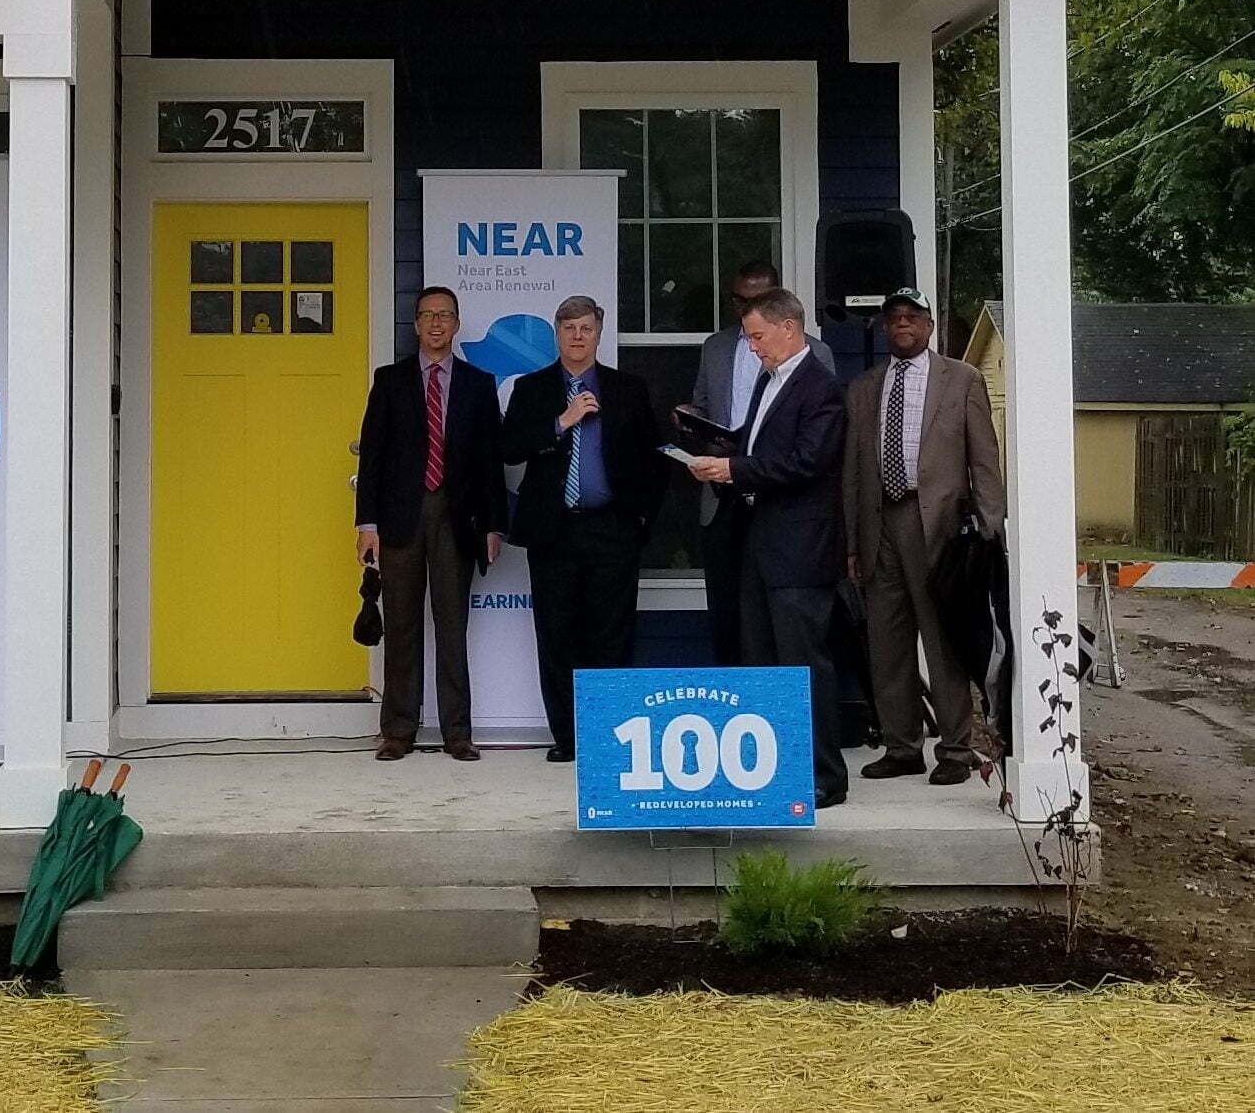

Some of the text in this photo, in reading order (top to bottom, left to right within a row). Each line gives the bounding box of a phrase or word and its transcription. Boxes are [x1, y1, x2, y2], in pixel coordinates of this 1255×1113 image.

[203, 108, 316, 149] 2517
[457, 222, 584, 256] NEAR
[457, 264, 527, 277] Near East
[457, 279, 555, 292] Area Renewal
[643, 687, 740, 707] CELEBRATE
[613, 713, 778, 791] 100
[639, 800, 754, 810] REDEVELOPED HOMES
